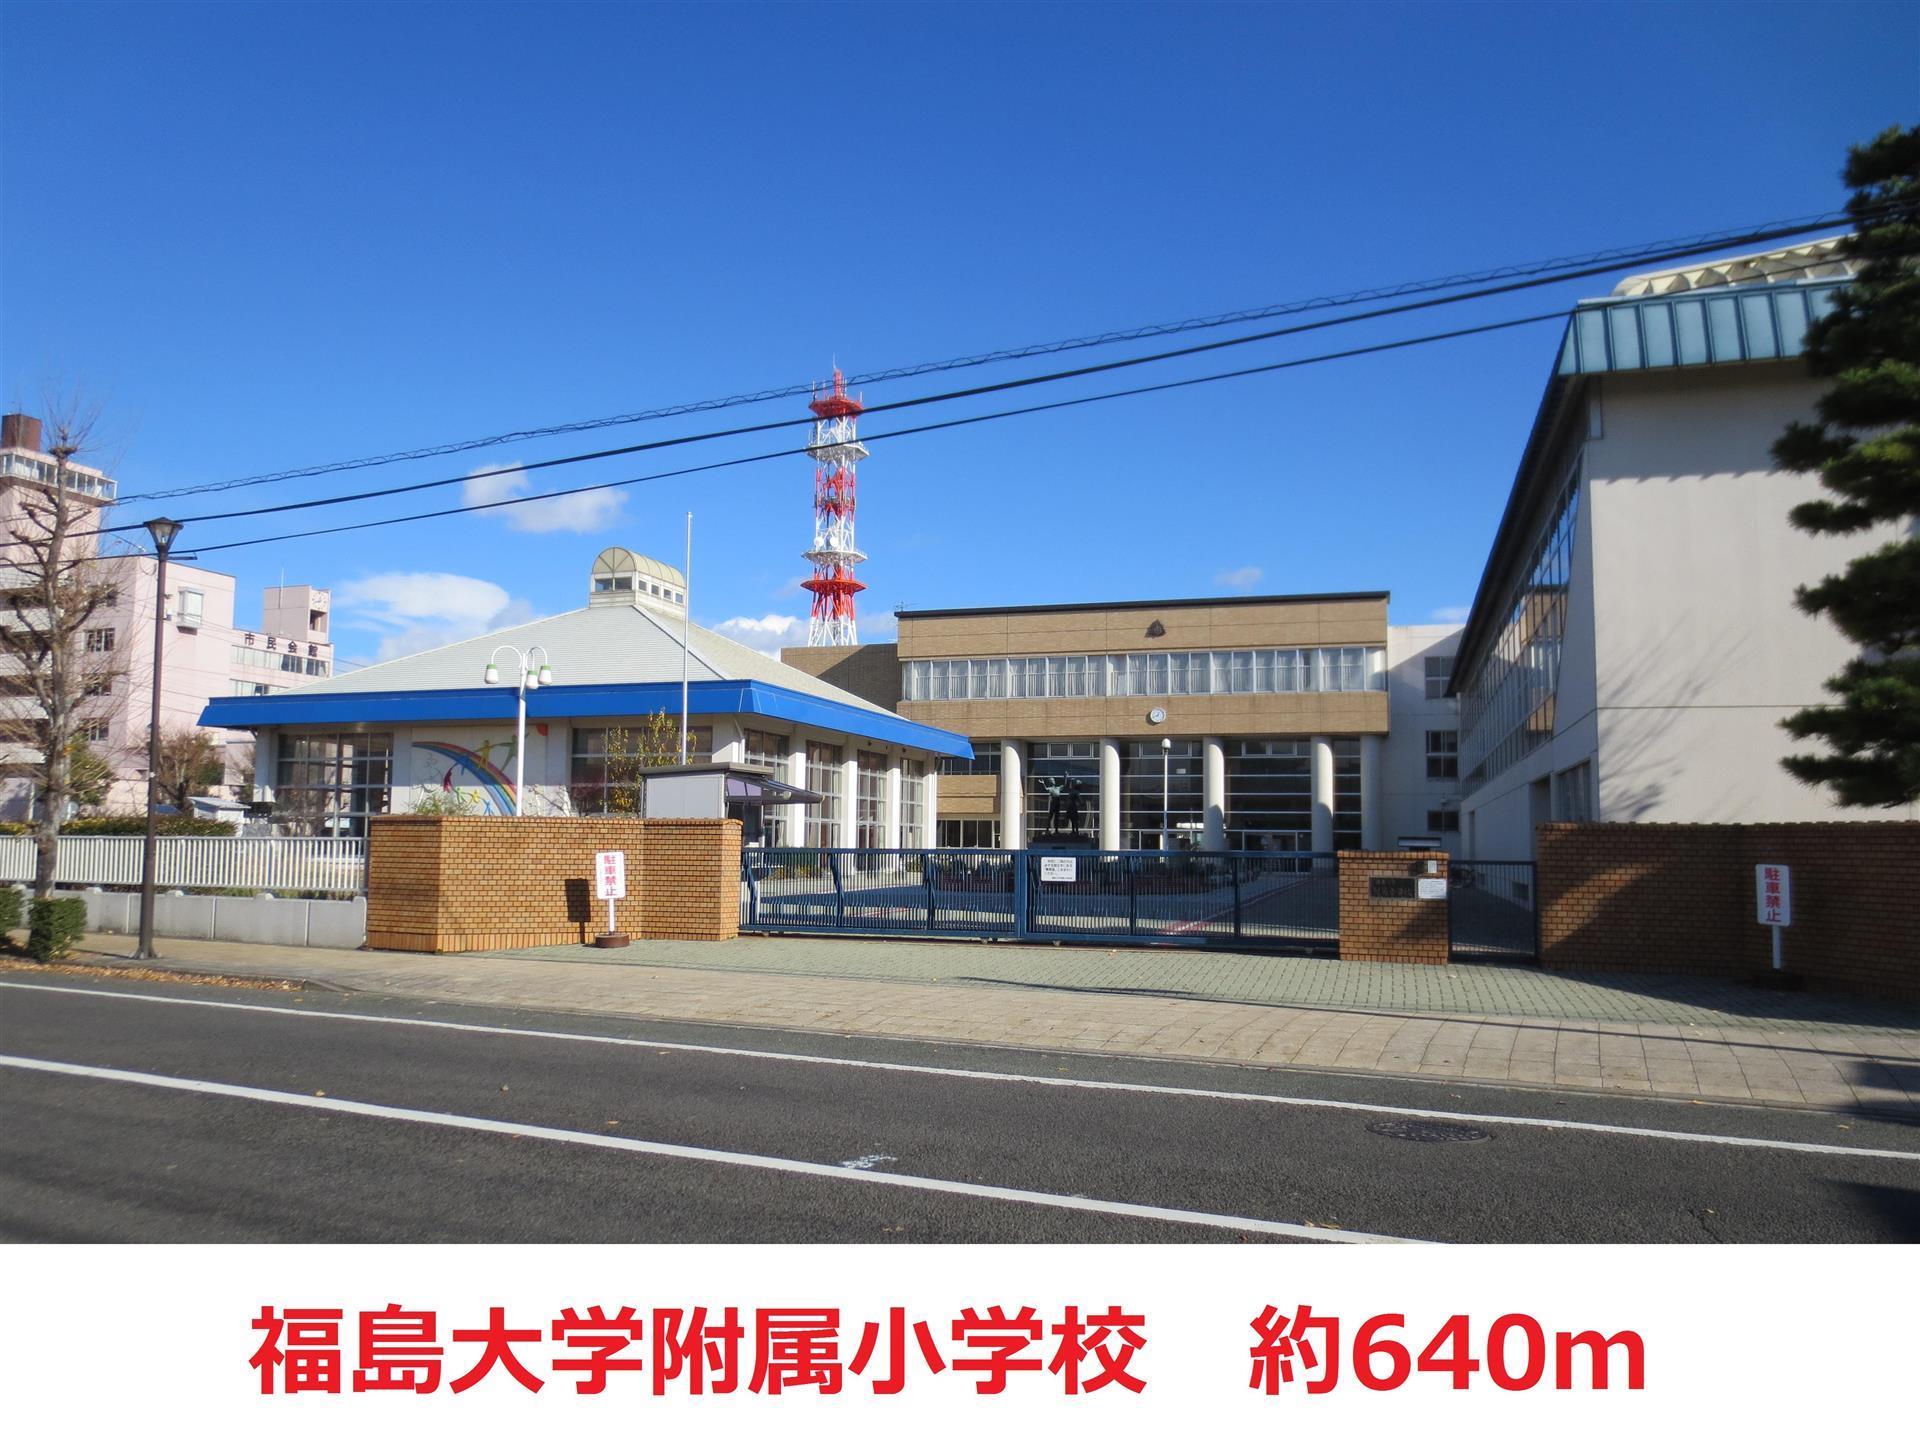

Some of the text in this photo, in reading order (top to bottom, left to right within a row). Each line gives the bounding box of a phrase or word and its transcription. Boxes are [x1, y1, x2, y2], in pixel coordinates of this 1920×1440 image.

[245, 633, 318, 657] 市民会館
[603, 855, 617, 896] 駐車禁止
[1764, 867, 1781, 922] 駐車禁止
